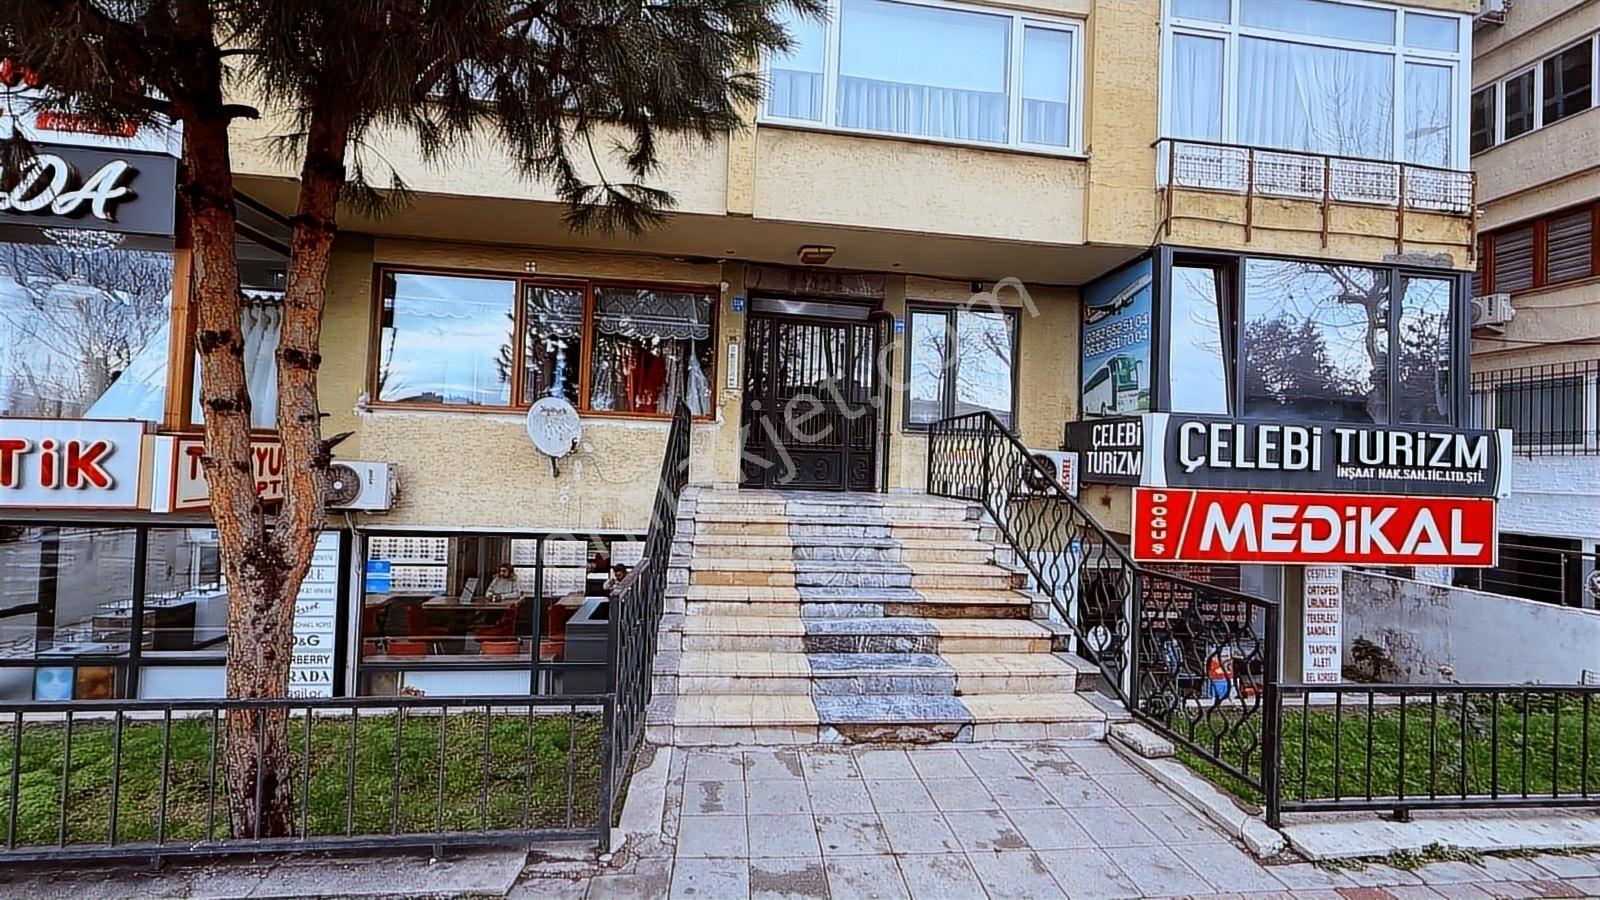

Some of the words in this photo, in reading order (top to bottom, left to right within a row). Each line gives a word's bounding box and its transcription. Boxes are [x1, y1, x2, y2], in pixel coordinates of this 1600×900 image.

[0, 439, 110, 488] TiK
[1151, 493, 1168, 555] DOĞUŞ
[291, 655, 330, 664] RBERRY
[290, 670, 330, 682] RADA
